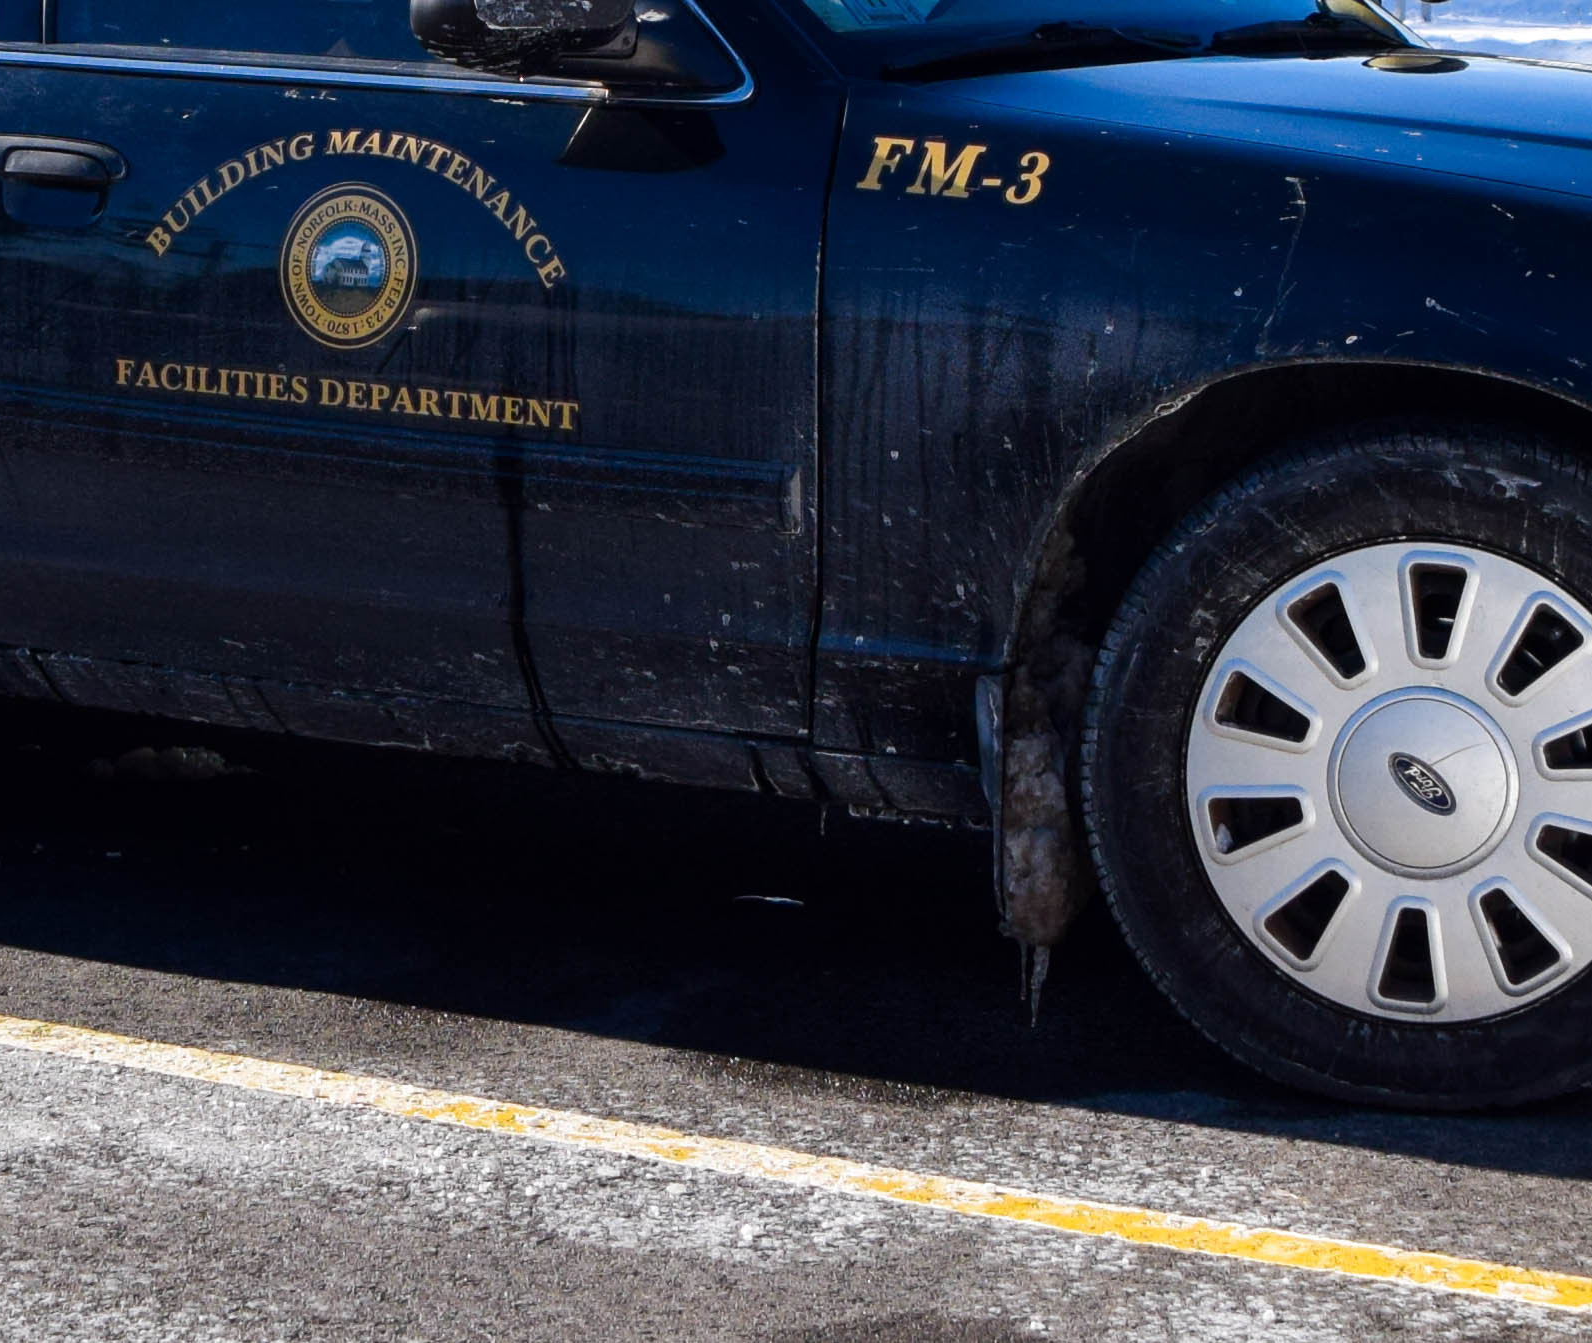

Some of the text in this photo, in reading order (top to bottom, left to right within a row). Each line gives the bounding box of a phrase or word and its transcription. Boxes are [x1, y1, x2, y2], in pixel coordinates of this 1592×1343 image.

[856, 136, 1050, 205] FM-3
[145, 129, 567, 289] BUILDING MAINTENANCE
[115, 359, 579, 431] FACILITIES DEPARTMENT
[1404, 766, 1442, 798] Ford
